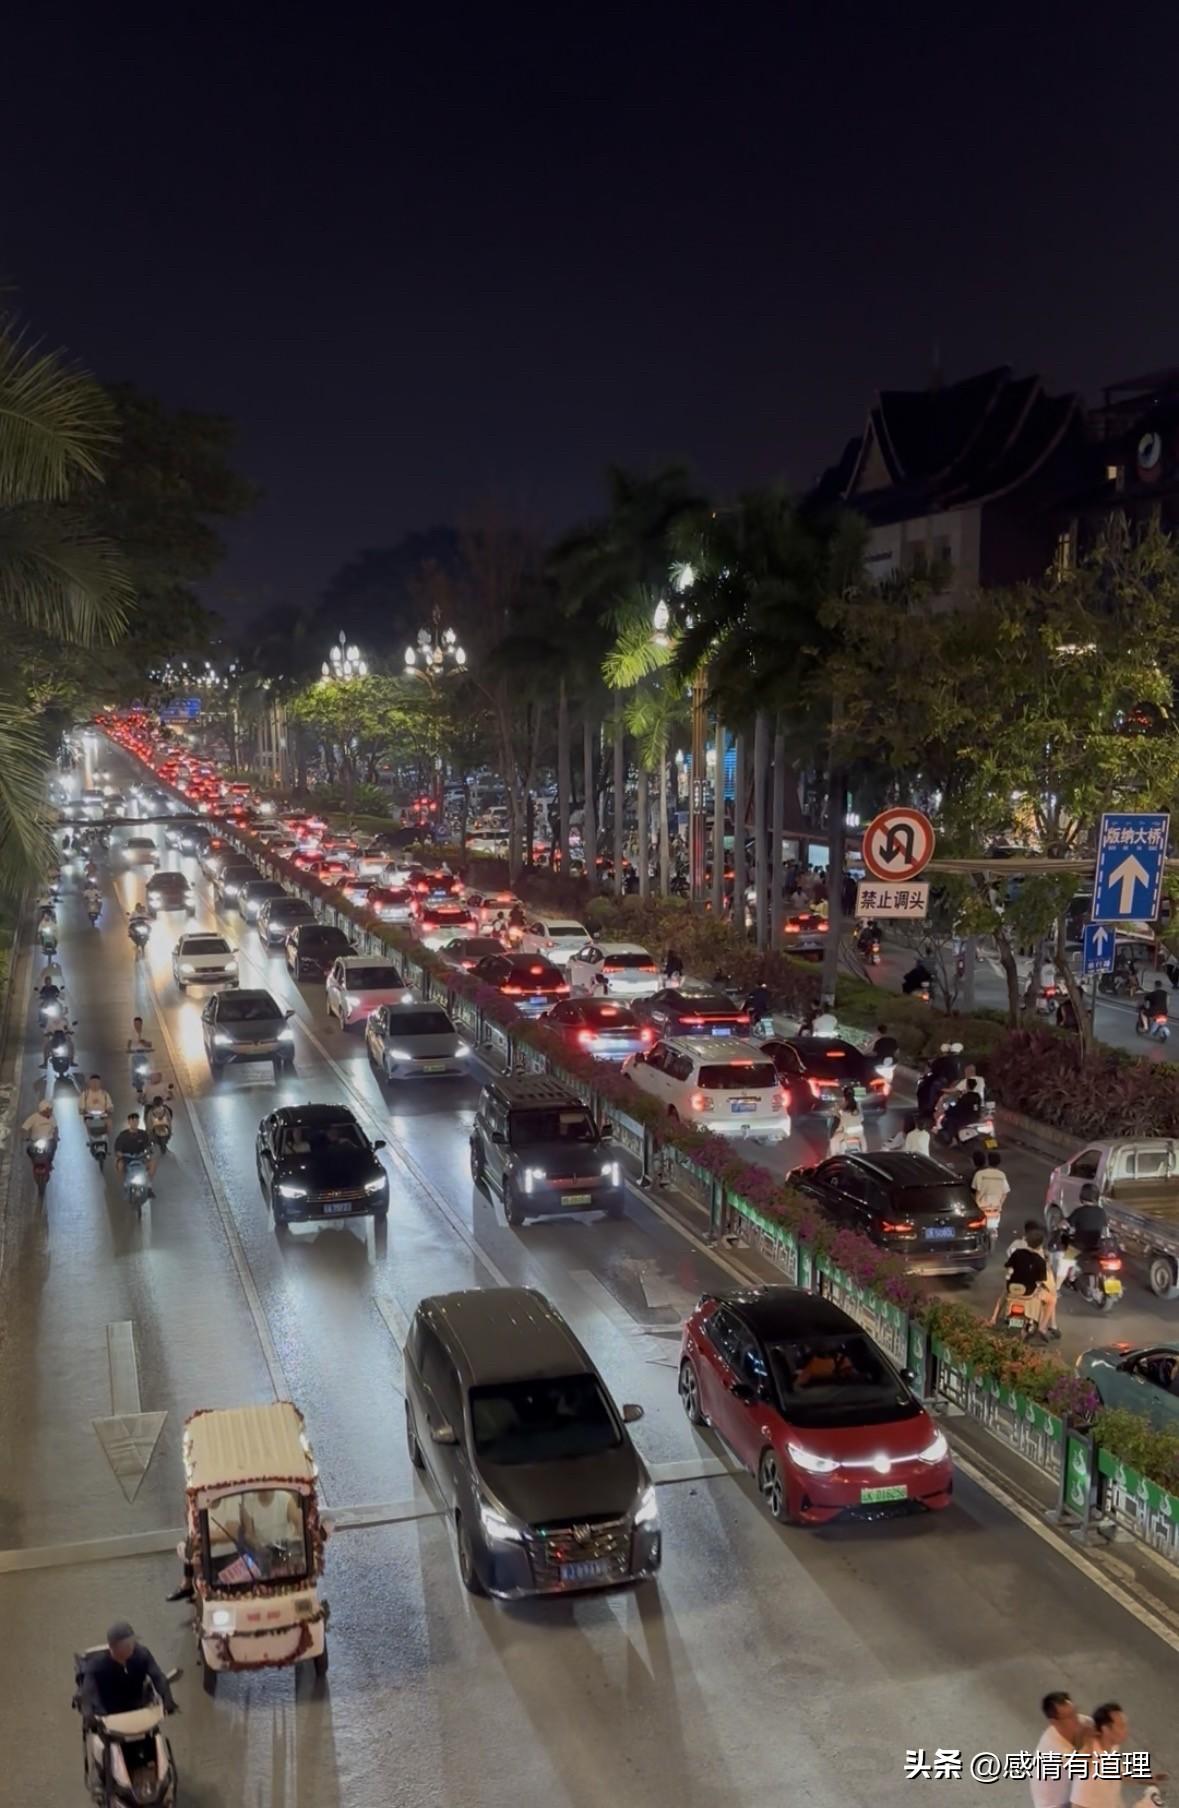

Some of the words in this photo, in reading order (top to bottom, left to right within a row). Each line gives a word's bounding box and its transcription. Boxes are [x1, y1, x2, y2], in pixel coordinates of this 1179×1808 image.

[1106, 827, 1162, 845] 版纳大桥
[861, 890, 925, 910] 禁止调头
